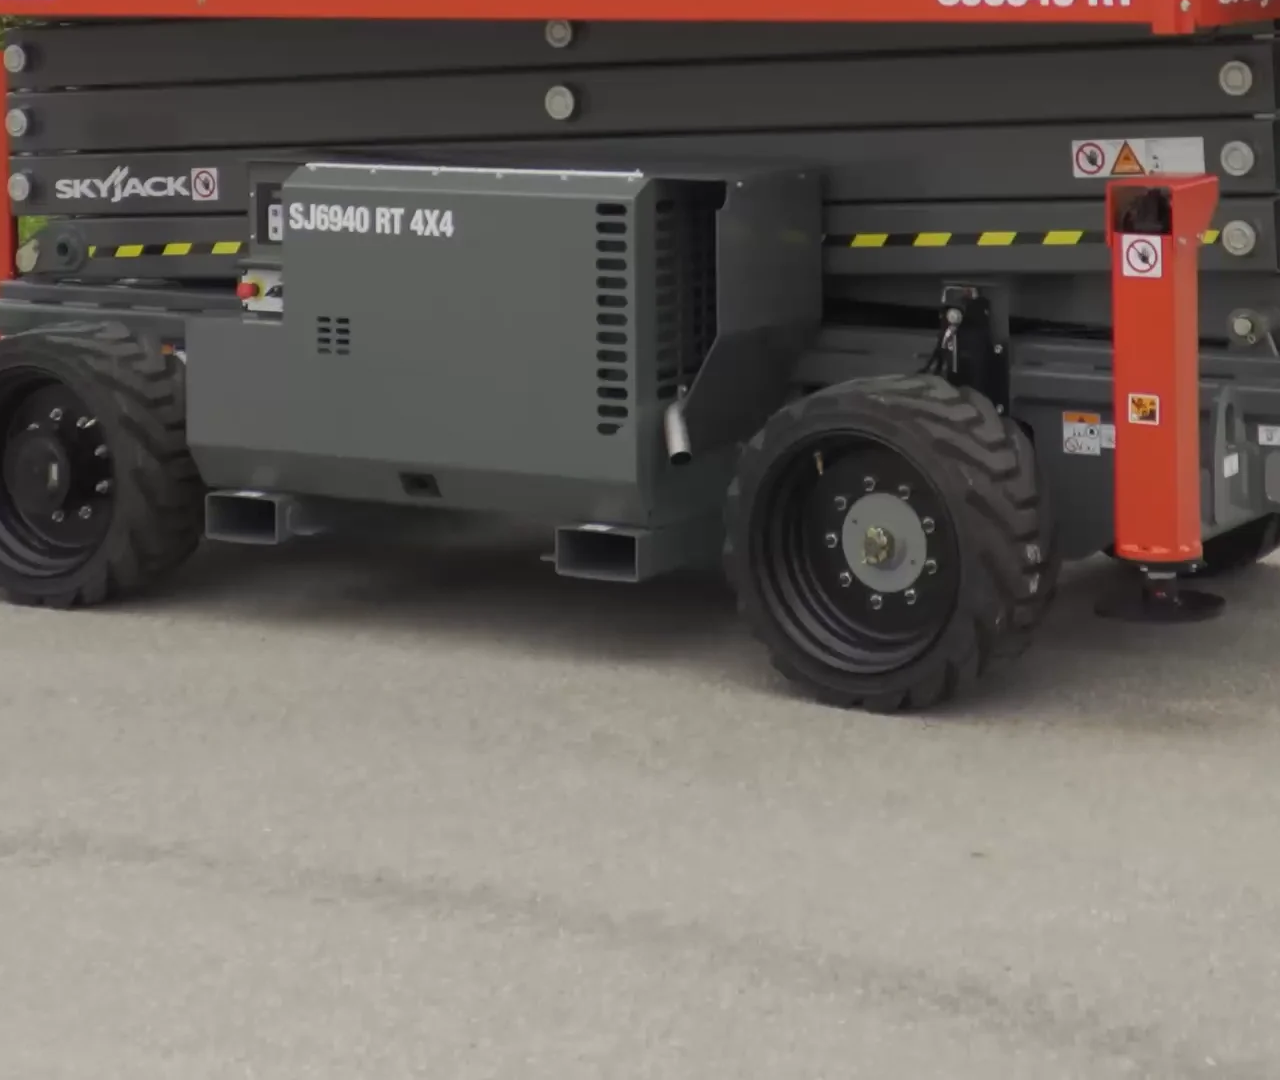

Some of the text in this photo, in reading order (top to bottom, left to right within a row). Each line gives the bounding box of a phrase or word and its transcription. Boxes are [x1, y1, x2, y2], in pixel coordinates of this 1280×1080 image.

[55, 166, 189, 202] SKYJACK
[288, 202, 455, 238] SJ6940 RT 4X4
